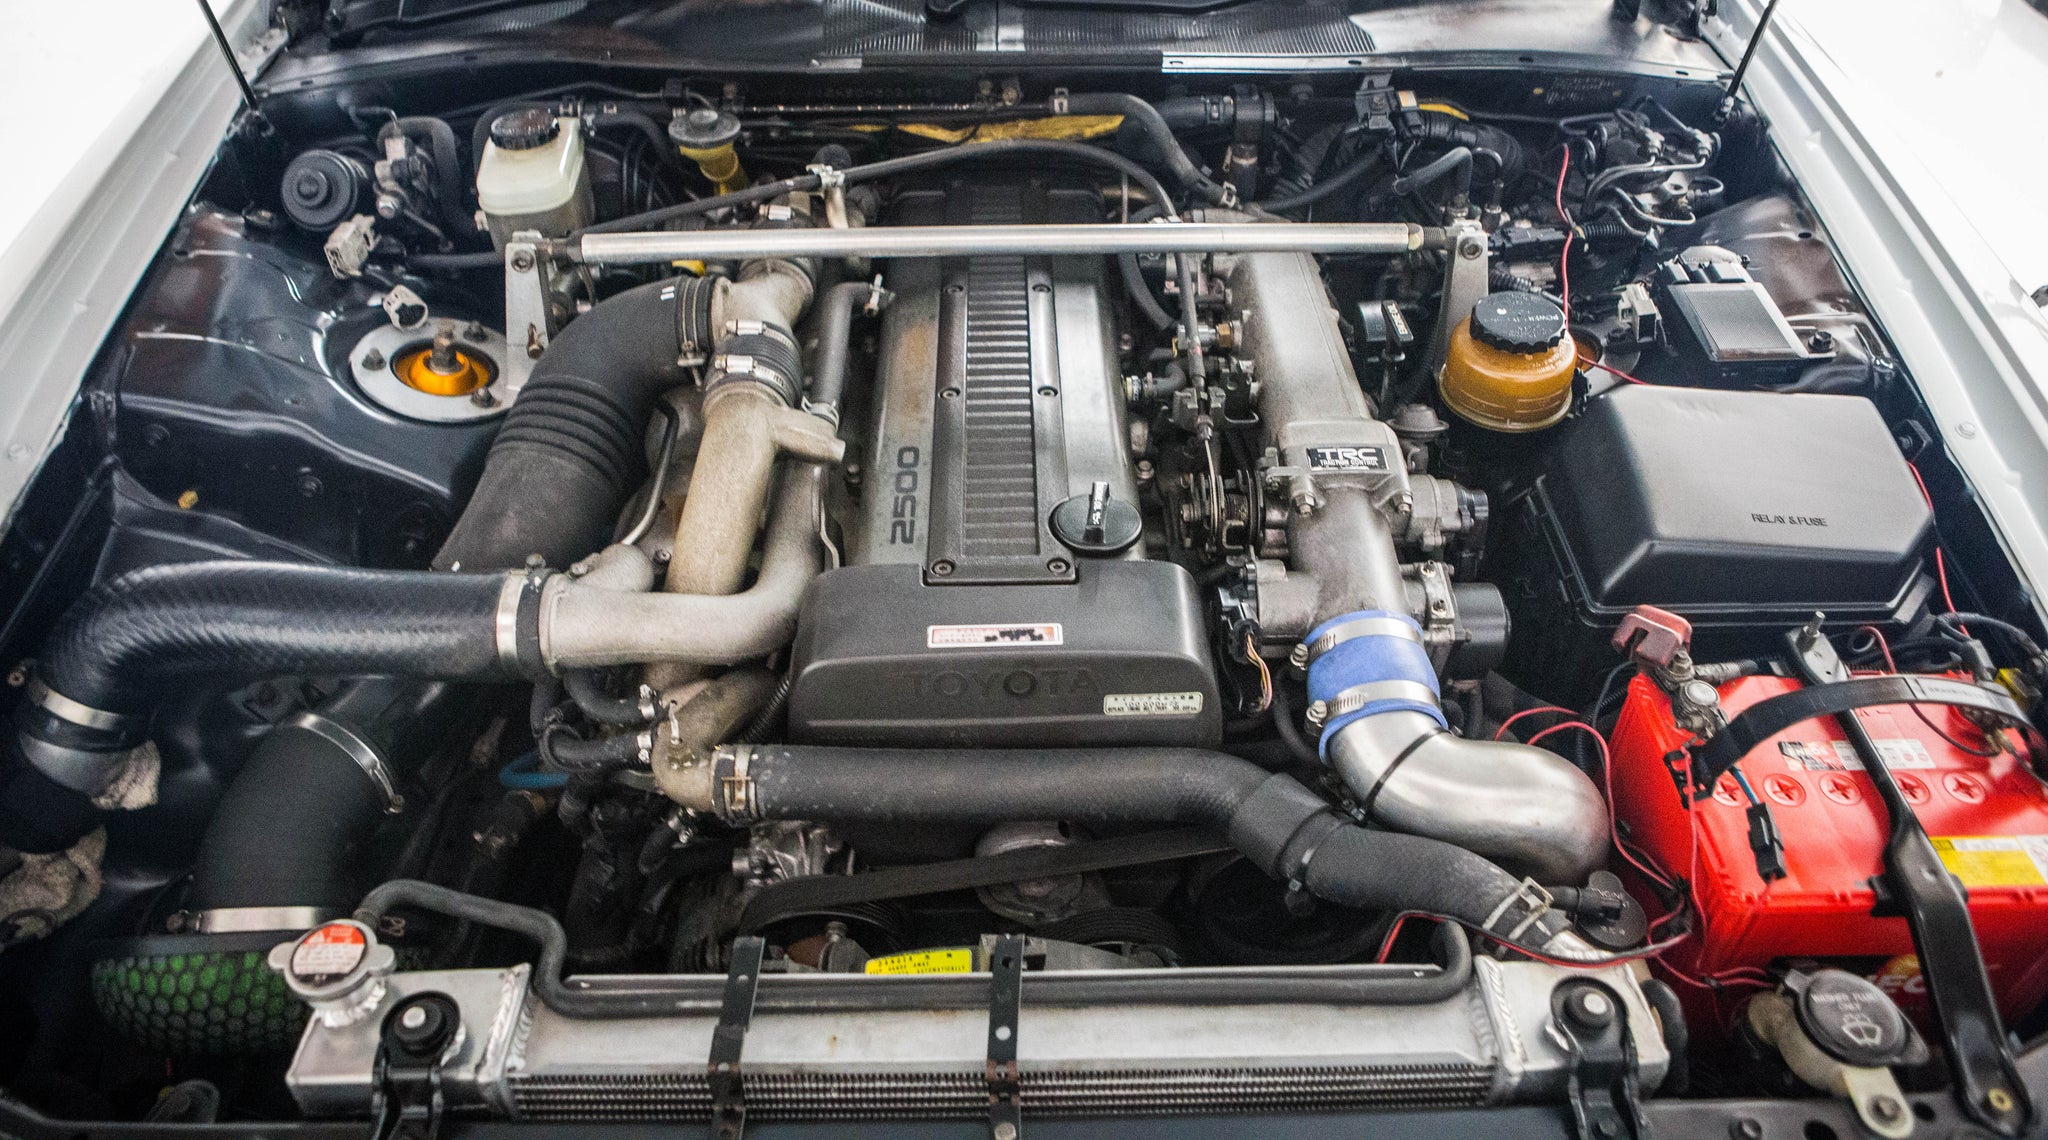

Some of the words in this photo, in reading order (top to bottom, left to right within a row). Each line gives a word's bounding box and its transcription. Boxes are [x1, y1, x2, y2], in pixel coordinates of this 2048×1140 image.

[1317, 448, 1378, 463] TRC
[890, 446, 920, 544] 2500
[1751, 513, 1785, 524] RELAY
[1788, 516, 1798, 525] &
[1797, 516, 1828, 527] FUSE
[903, 669, 1099, 698] TOYOTA
